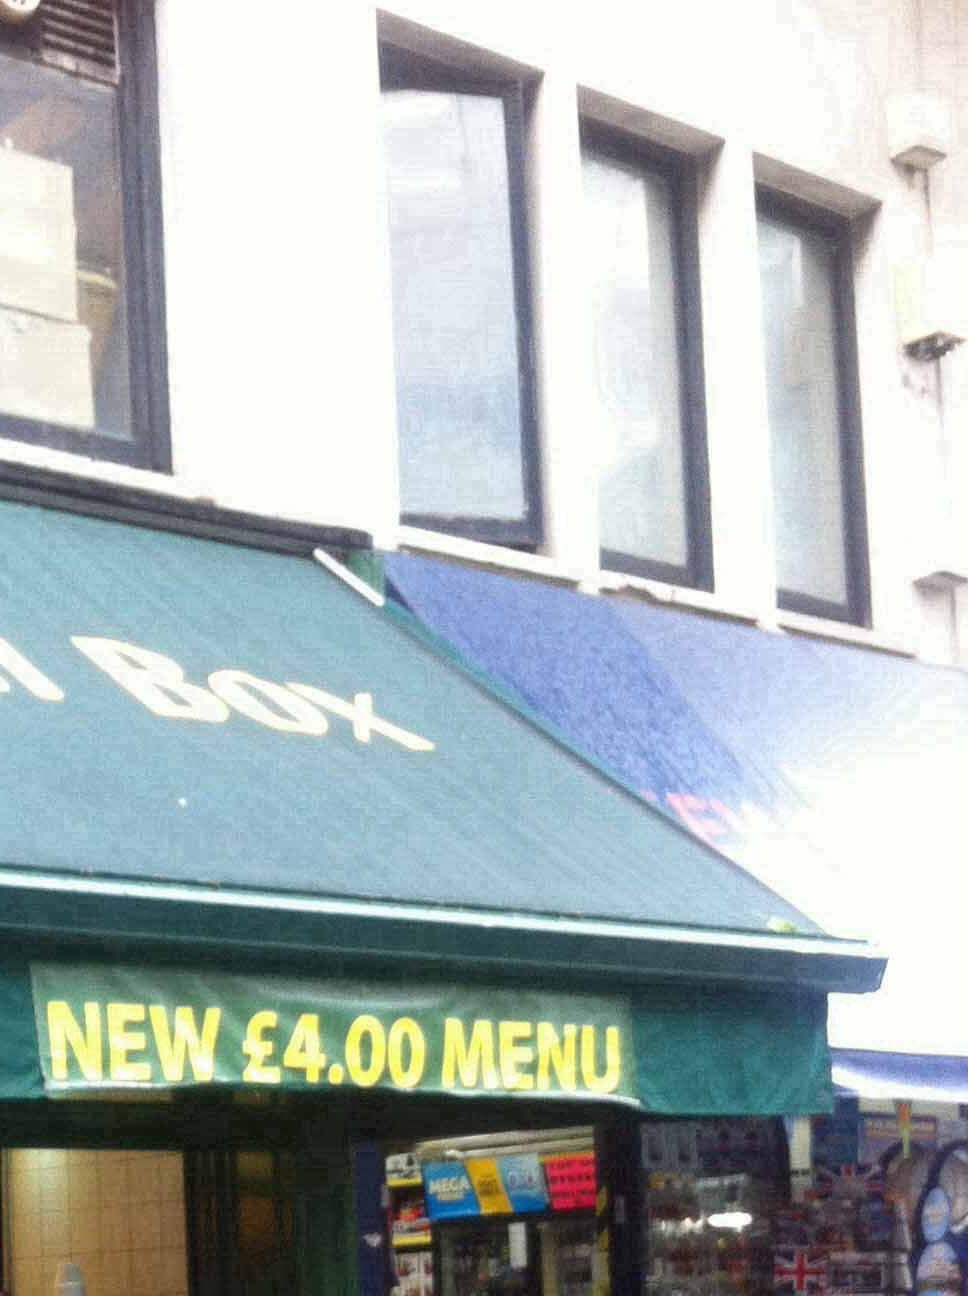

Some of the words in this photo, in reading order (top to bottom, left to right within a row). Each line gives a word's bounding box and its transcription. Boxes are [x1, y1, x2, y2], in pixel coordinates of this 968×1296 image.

[70, 635, 435, 752] Box
[45, 1000, 222, 1083] NEW
[242, 1010, 427, 1090] £4.00
[441, 1016, 623, 1095] MENU
